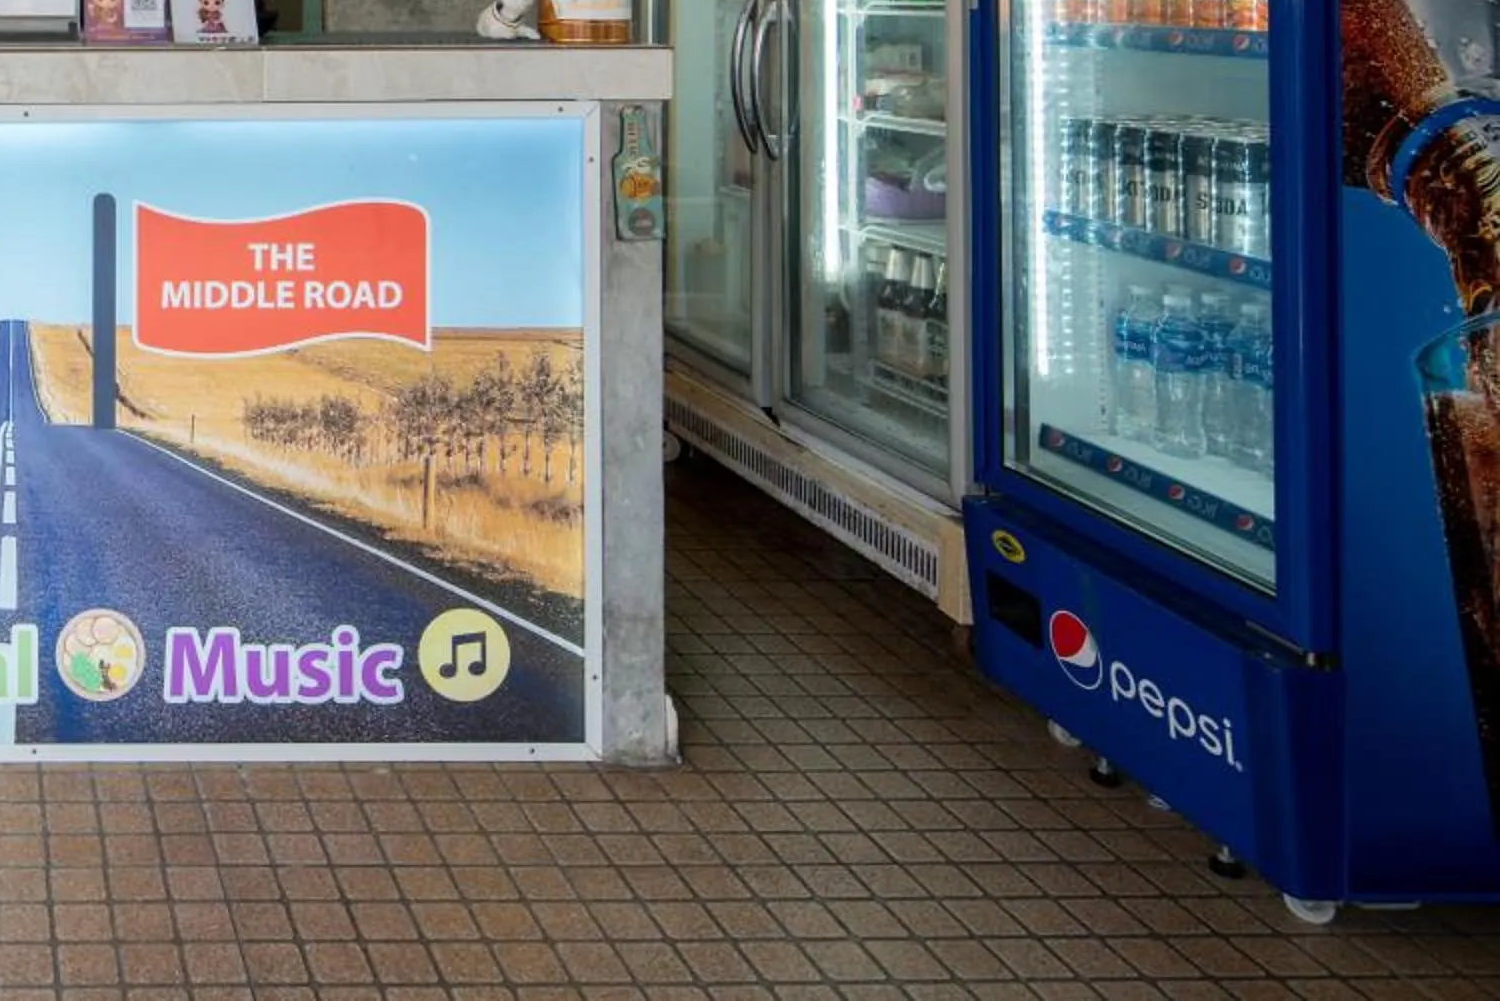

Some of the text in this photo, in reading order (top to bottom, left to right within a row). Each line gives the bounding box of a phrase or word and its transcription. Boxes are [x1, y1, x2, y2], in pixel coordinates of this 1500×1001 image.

[248, 242, 316, 272] THE
[160, 280, 404, 309] MIDDLE ROAD
[165, 625, 403, 703] Music
[1110, 660, 1240, 769] pepsi
